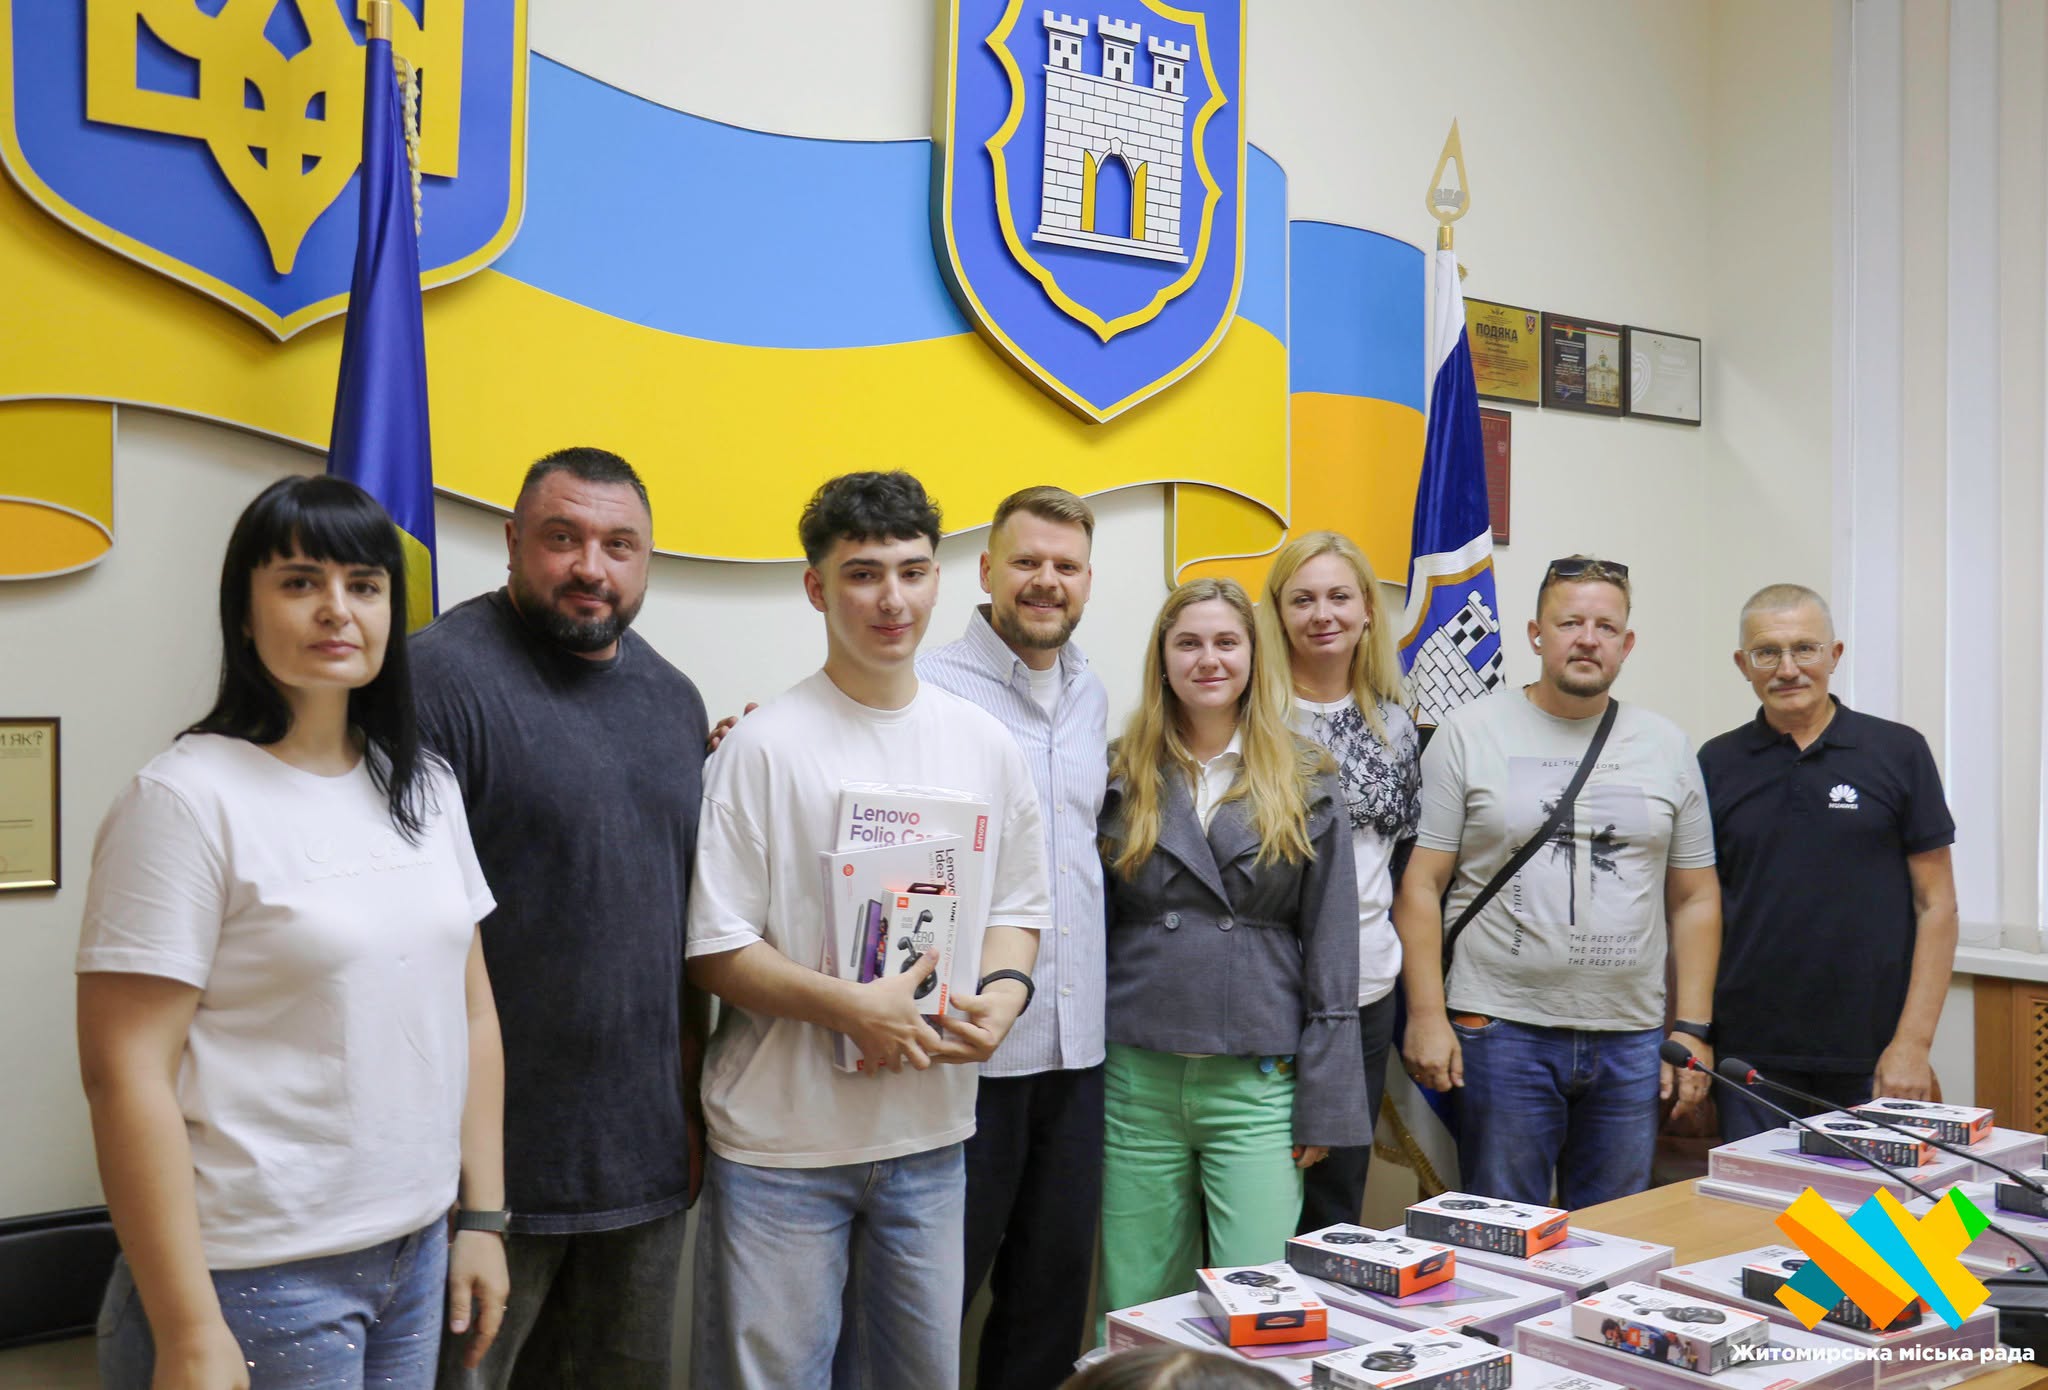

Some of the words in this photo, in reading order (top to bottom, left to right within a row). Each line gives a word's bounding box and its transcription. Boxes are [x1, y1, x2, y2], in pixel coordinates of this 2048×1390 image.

[1476, 322, 1519, 342] ПОДЯКА
[1563, 760, 1581, 768] THE
[852, 803, 921, 826] Lenovo
[850, 824, 896, 843] Folio
[975, 818, 986, 850] Lenovo
[935, 850, 946, 879] Idea
[945, 848, 956, 895] Lenovo
[912, 931, 935, 944] ZERO
[1510, 924, 1524, 956] UMB
[1569, 933, 1588, 942] THE
[1590, 935, 1614, 943] REST
[1616, 935, 1627, 943] OF
[1569, 946, 1587, 954] THE
[1589, 947, 1614, 955] REST
[1615, 947, 1627, 955] OF
[1568, 957, 1586, 966] THE
[1588, 958, 1612, 967] REST
[1614, 959, 1626, 967] OF
